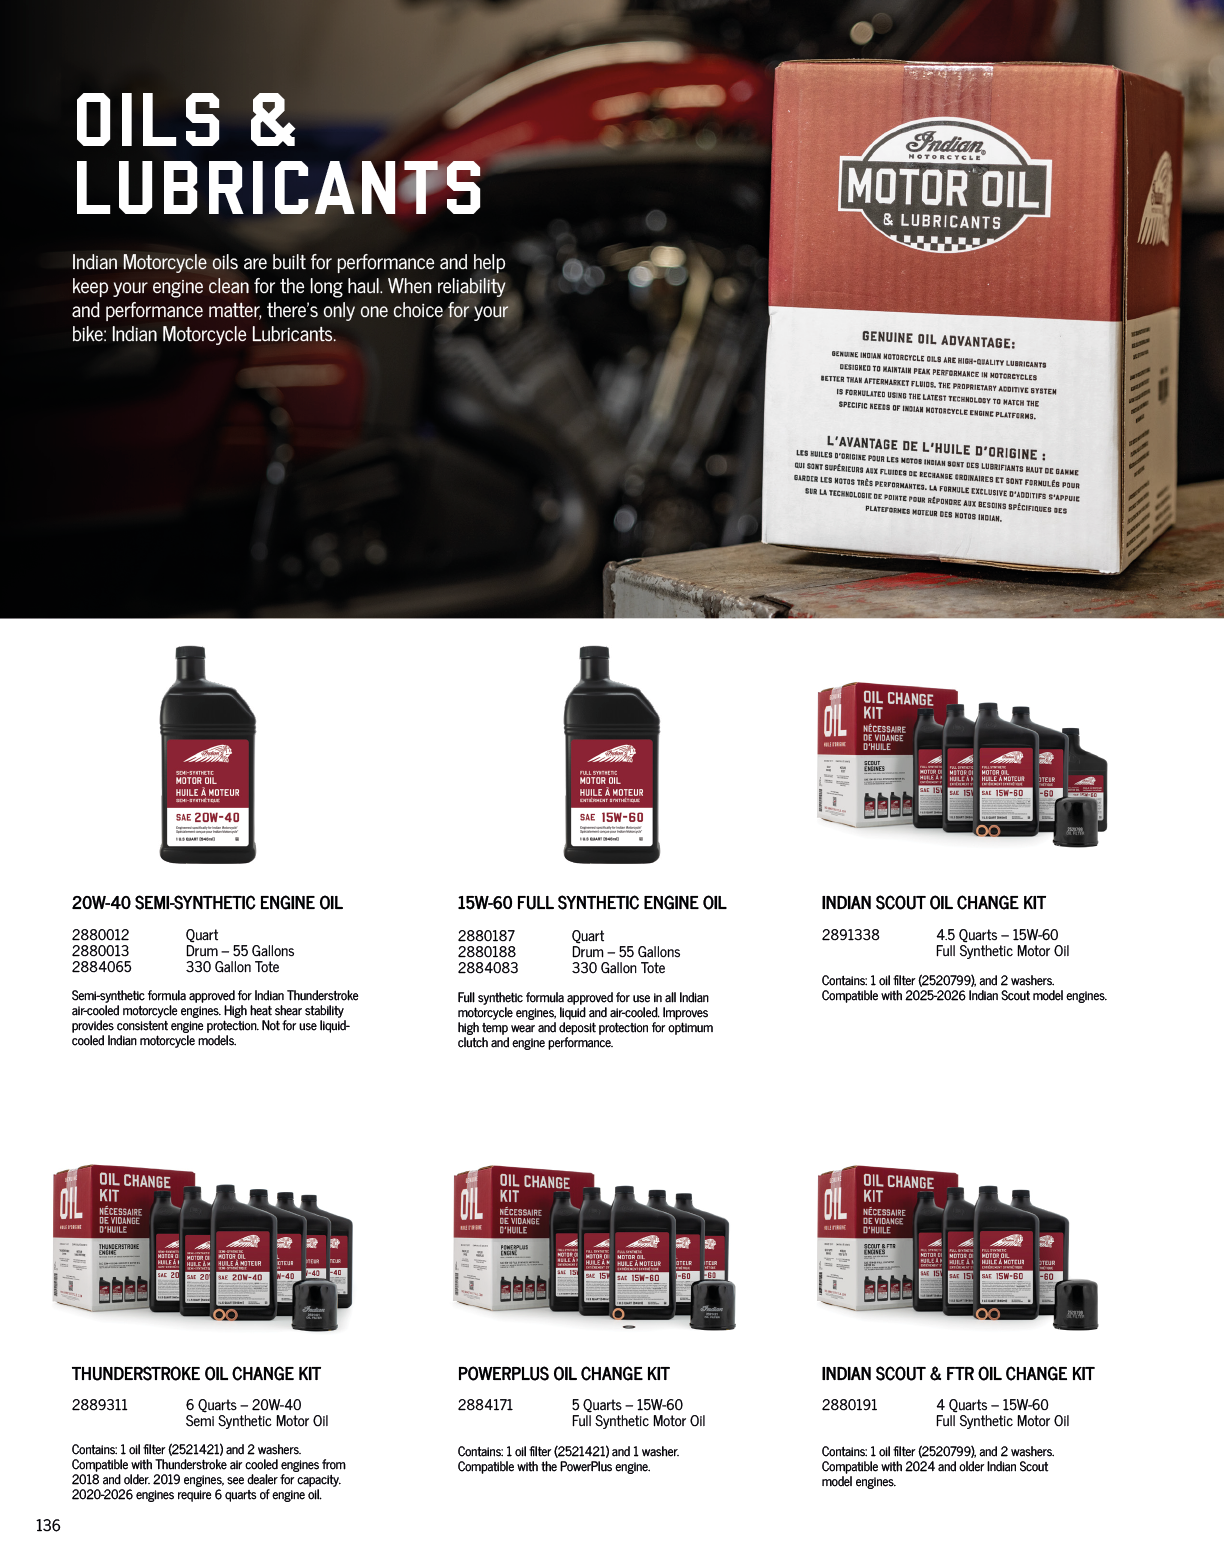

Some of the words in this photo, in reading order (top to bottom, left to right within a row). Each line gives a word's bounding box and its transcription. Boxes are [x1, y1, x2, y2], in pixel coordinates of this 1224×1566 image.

[848, 167, 968, 206] MOTOR
[982, 170, 1039, 208] OIL
[883, 213, 894, 226] &
[901, 213, 1001, 229] LUBRICANTS
[862, 330, 913, 344] GENUINE
[918, 334, 937, 345] OIL
[941, 335, 1016, 349] ADVANTAGE:
[831, 350, 858, 358] GENUINE
[860, 352, 881, 360] INDIAN
[883, 354, 925, 362] MOTORCYCLE
[926, 355, 942, 363] OILS
[943, 356, 956, 364] ARE
[958, 357, 1004, 366] HIGH-QUALITY
[1006, 360, 1047, 369] LUBRICANTS
[827, 435, 898, 451] L'AVANTAGE
[902, 440, 918, 452] DE
[922, 441, 970, 455] L'HUILE
[975, 445, 1038, 460] D'ORIGINE
[863, 690, 883, 704] OIL
[887, 691, 934, 707] CHANGE
[863, 706, 883, 720] KIT
[824, 704, 847, 737] OIL
[874, 734, 904, 742] VIDANGE
[863, 742, 891, 751] D'HUILE
[175, 777, 202, 785] MOTOR
[204, 777, 217, 785] OIL
[175, 789, 199, 797] HUILE
[208, 789, 240, 797] MOTEUR
[176, 813, 192, 821] SAE
[194, 812, 240, 823] 20W-40
[580, 813, 595, 821] SAE
[602, 812, 644, 823] 15W-60
[72, 896, 131, 909] 20W-40
[135, 895, 255, 910] SEMI-SYNTHETIC
[261, 895, 315, 910] ENGINE
[320, 895, 343, 910] OIL
[72, 929, 129, 940] 2880012
[822, 929, 879, 940] 2891338
[937, 945, 955, 956] Full
[960, 945, 1013, 959] Synthetic
[1018, 945, 1050, 956] Motor
[1054, 945, 1069, 956] Oil
[99, 1172, 120, 1186] OIL
[123, 1174, 171, 1189] CHANGE
[99, 1189, 119, 1202] KIT
[72, 1366, 200, 1381] THUNDERSTROKE
[205, 1366, 228, 1381] OIL
[232, 1366, 294, 1381] CHANGE
[299, 1367, 321, 1380] KIT
[459, 1366, 549, 1381] POWERPLUS
[554, 1366, 577, 1381] OIL
[581, 1366, 643, 1381] CHANGE
[648, 1367, 670, 1380] KIT
[458, 1399, 513, 1410] 2884171
[72, 1444, 117, 1455] Contains:
[121, 1444, 126, 1455] 1
[129, 1444, 140, 1455] oil
[143, 1444, 165, 1455] filter
[168, 1443, 223, 1456] (2521421)
[226, 1444, 244, 1455] and
[247, 1444, 255, 1455] 2
[258, 1444, 301, 1455] washers.
[36, 1519, 60, 1532] 136
